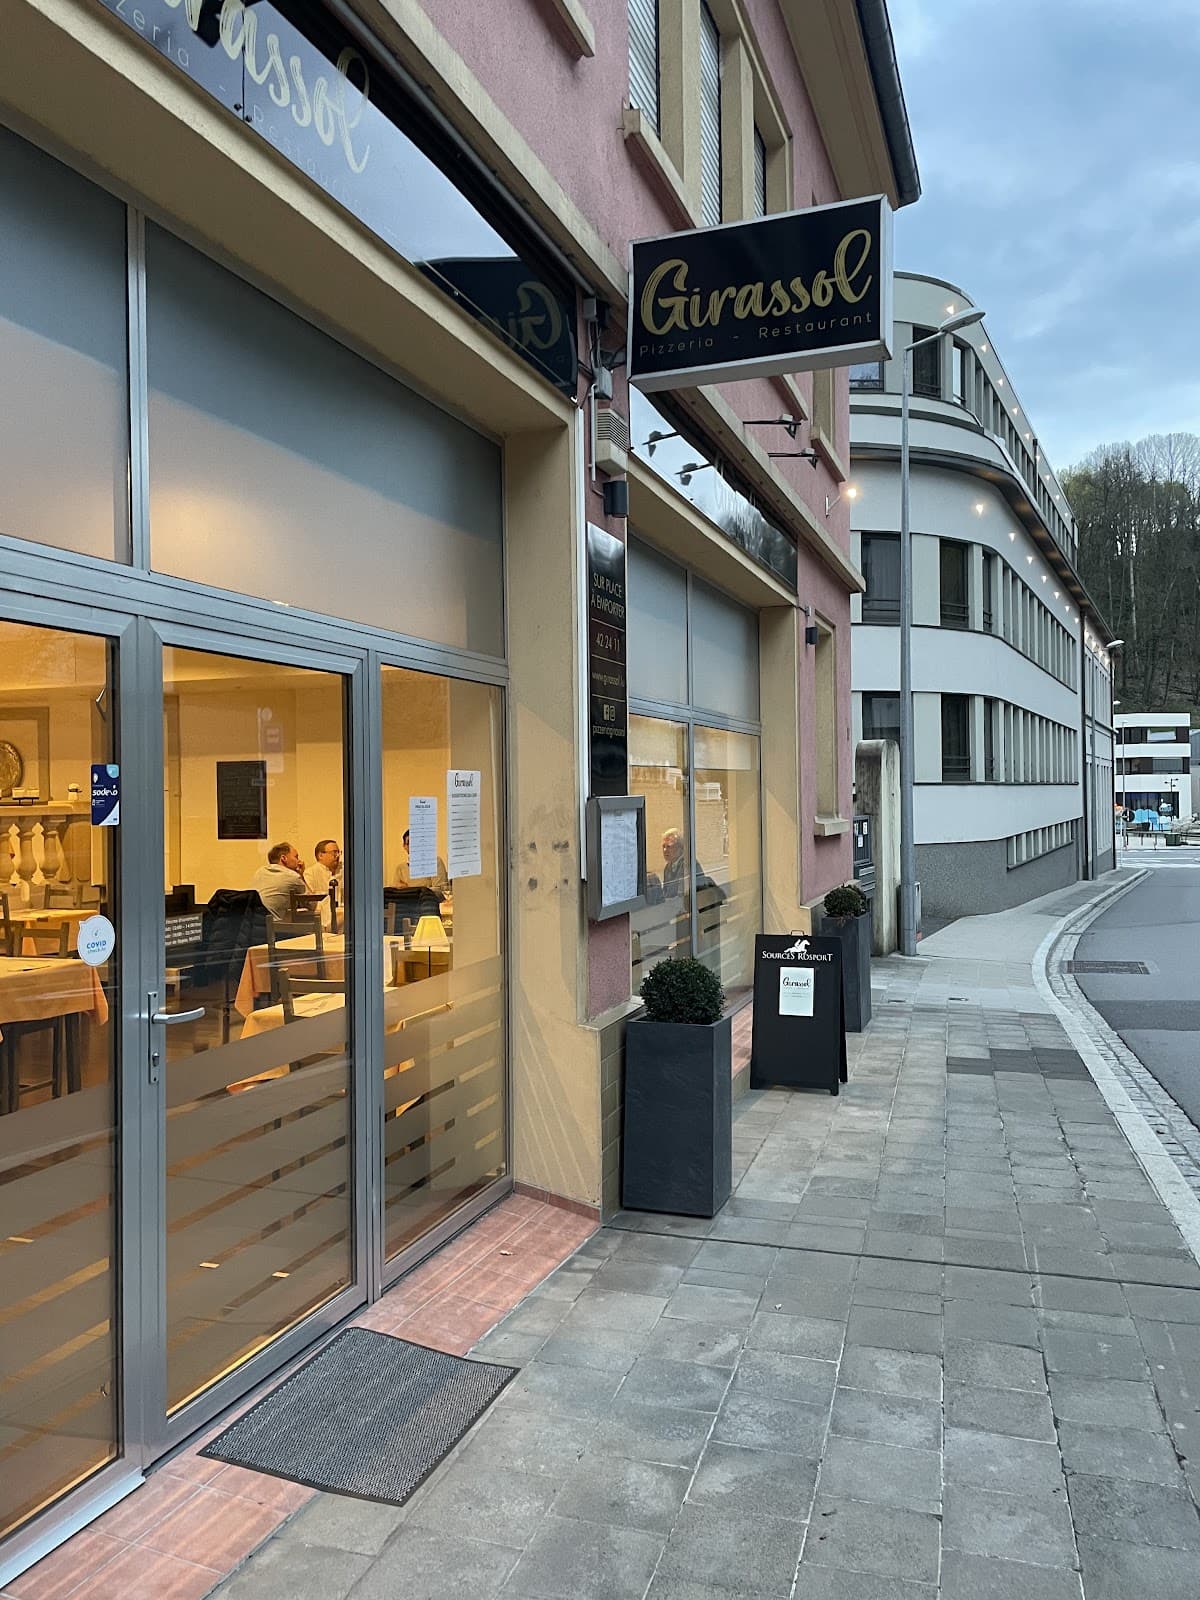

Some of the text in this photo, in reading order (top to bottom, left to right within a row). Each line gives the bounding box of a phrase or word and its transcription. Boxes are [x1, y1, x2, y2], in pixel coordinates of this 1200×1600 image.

[164, 0, 370, 174] assol
[640, 229, 872, 336] Girassol
[640, 336, 714, 358] Pizzeria
[759, 311, 872, 339] Restaurant
[593, 572, 622, 598] SUR PLACE
[596, 594, 625, 618] EMPORTER
[596, 632, 620, 653] 42 24 11
[86, 940, 107, 949] COVID
[761, 950, 833, 961] SOURCES ROSPORT
